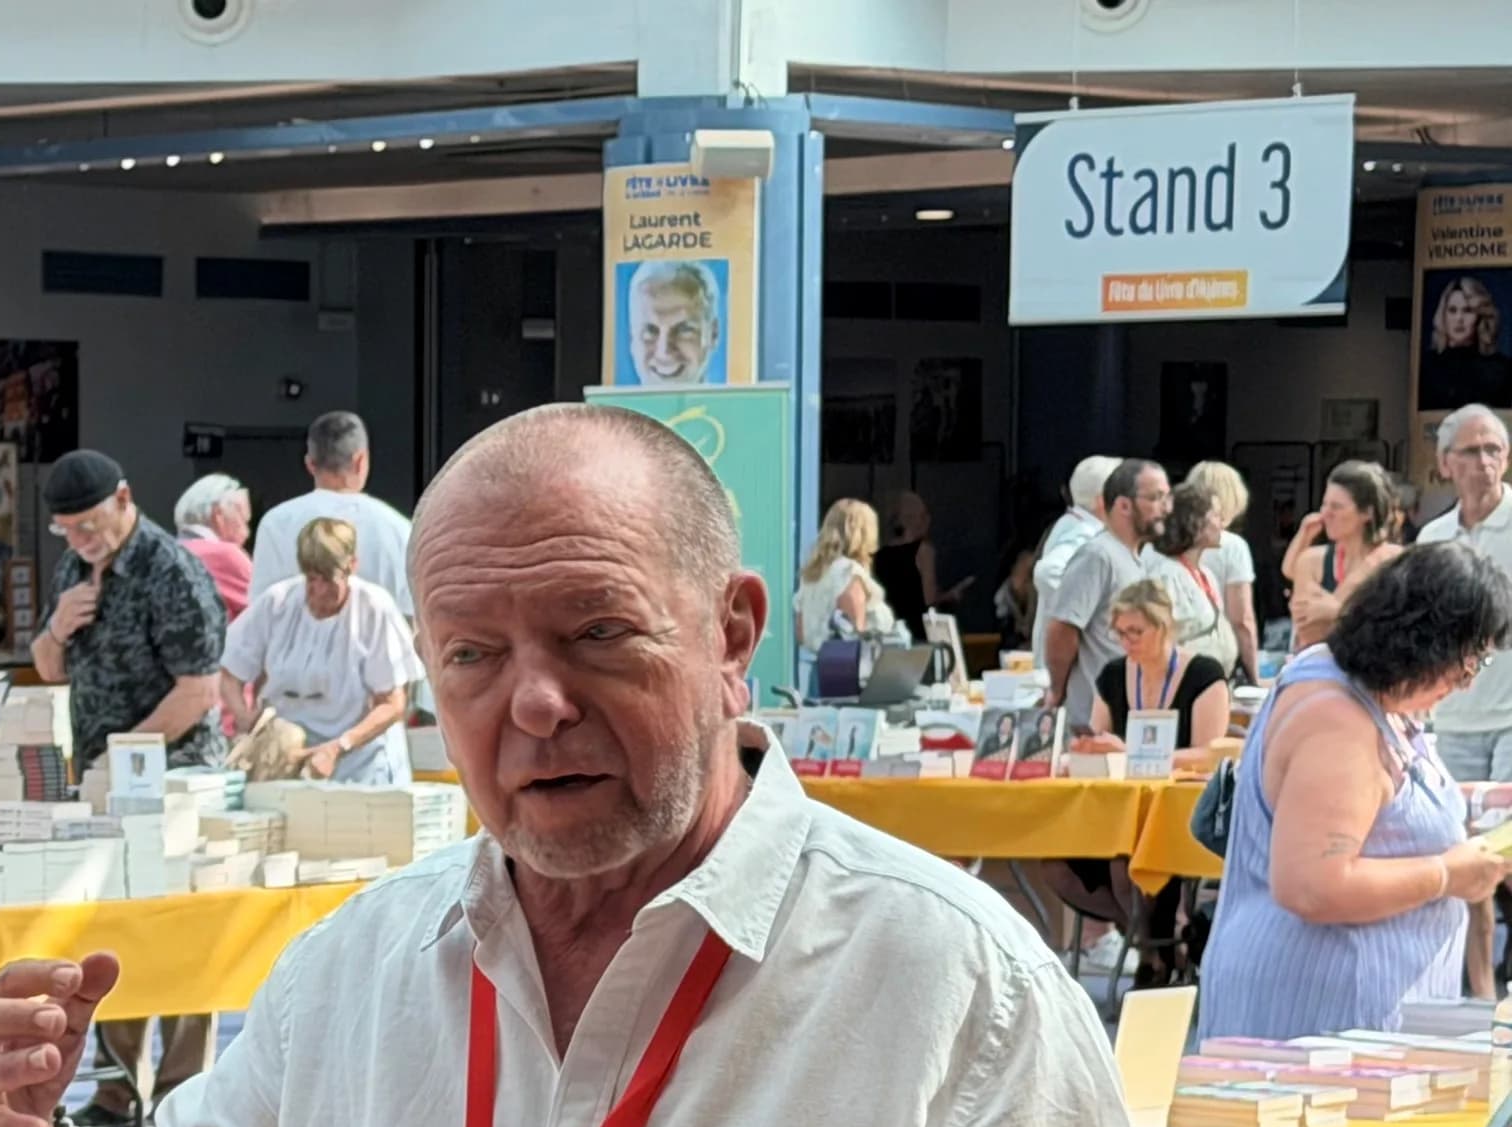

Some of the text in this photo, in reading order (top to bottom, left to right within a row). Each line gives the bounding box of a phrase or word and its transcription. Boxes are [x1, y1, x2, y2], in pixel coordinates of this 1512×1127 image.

[1064, 141, 1292, 239] Stand 3
[629, 211, 701, 229] Laurent
[623, 231, 713, 252] LAGARDE
